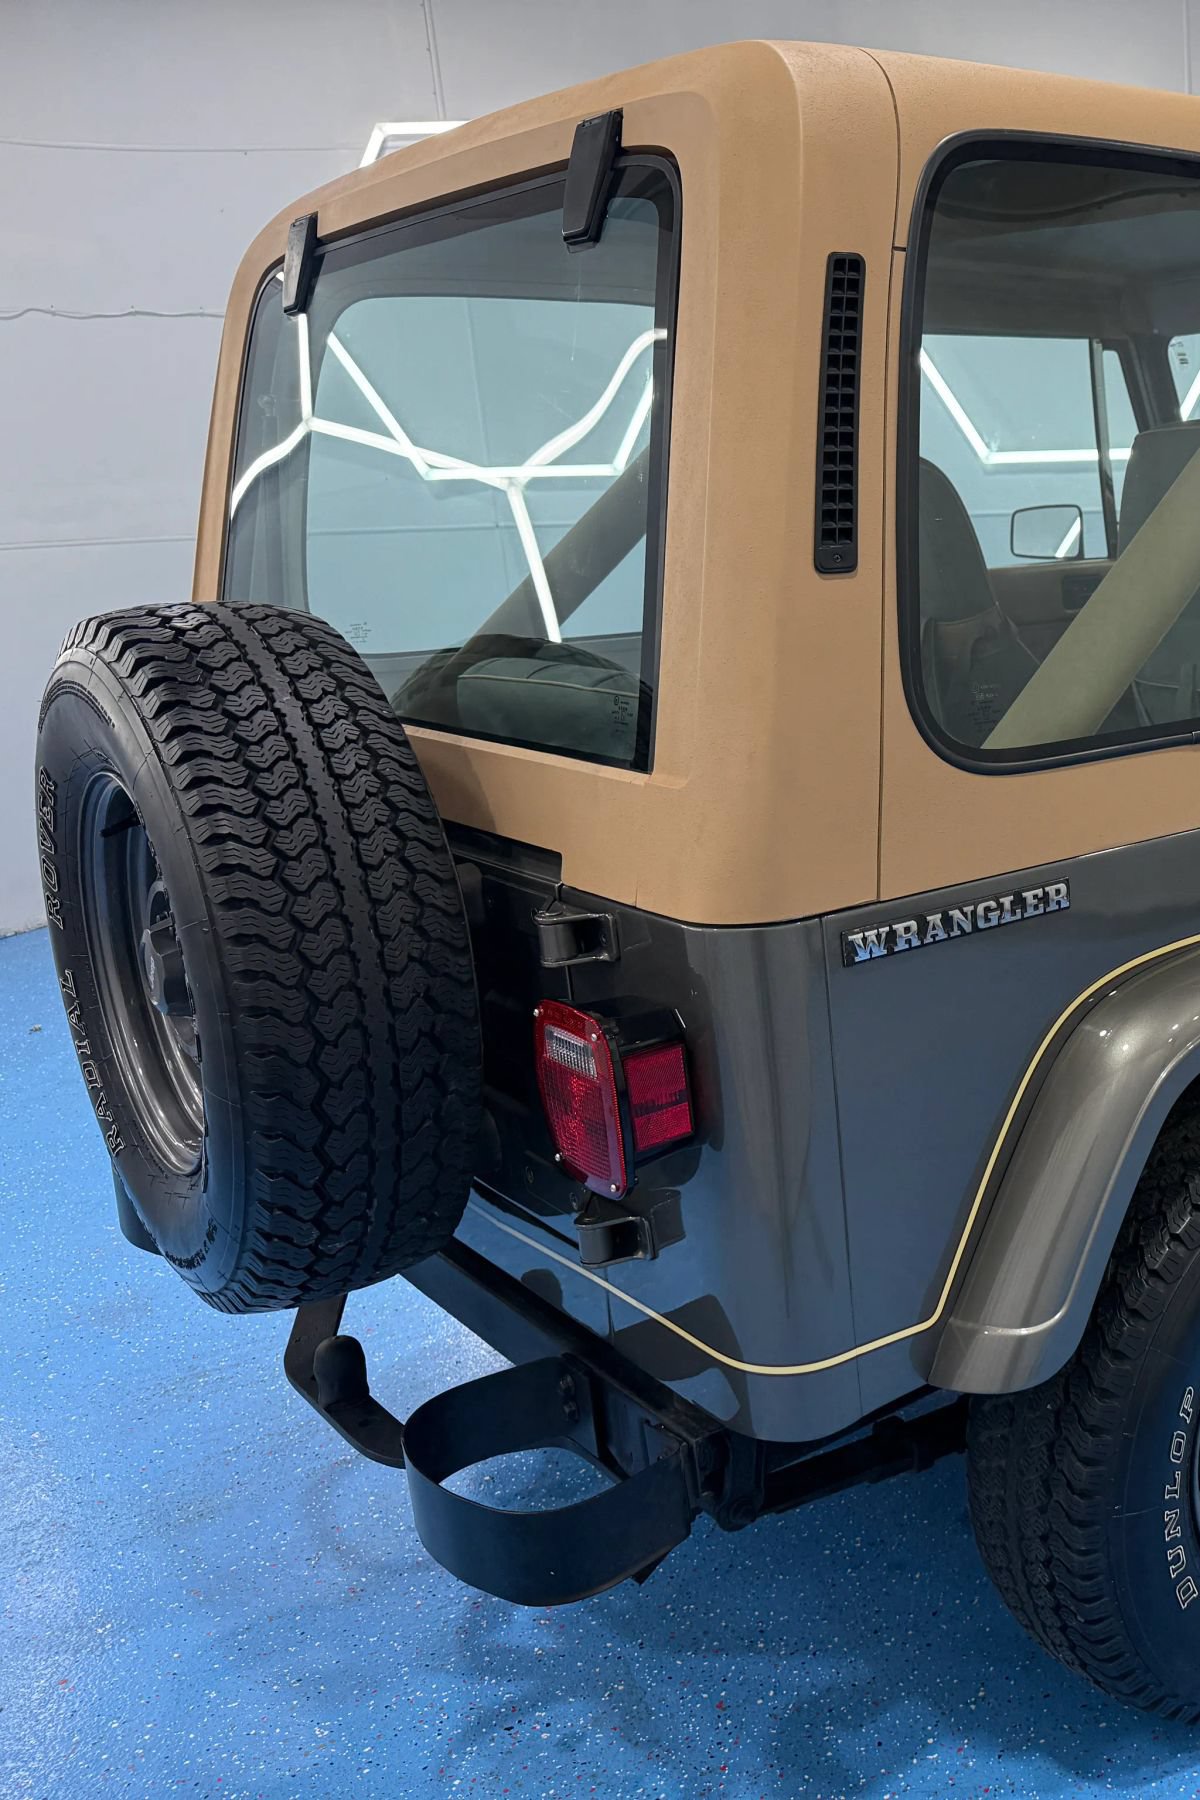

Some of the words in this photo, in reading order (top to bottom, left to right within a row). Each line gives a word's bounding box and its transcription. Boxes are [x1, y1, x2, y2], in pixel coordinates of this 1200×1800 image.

[38, 765, 64, 930] ROVER
[848, 883, 1069, 962] WRANGLER
[60, 968, 126, 1157] RADIAL
[1164, 1385, 1199, 1609] DUNLOP
